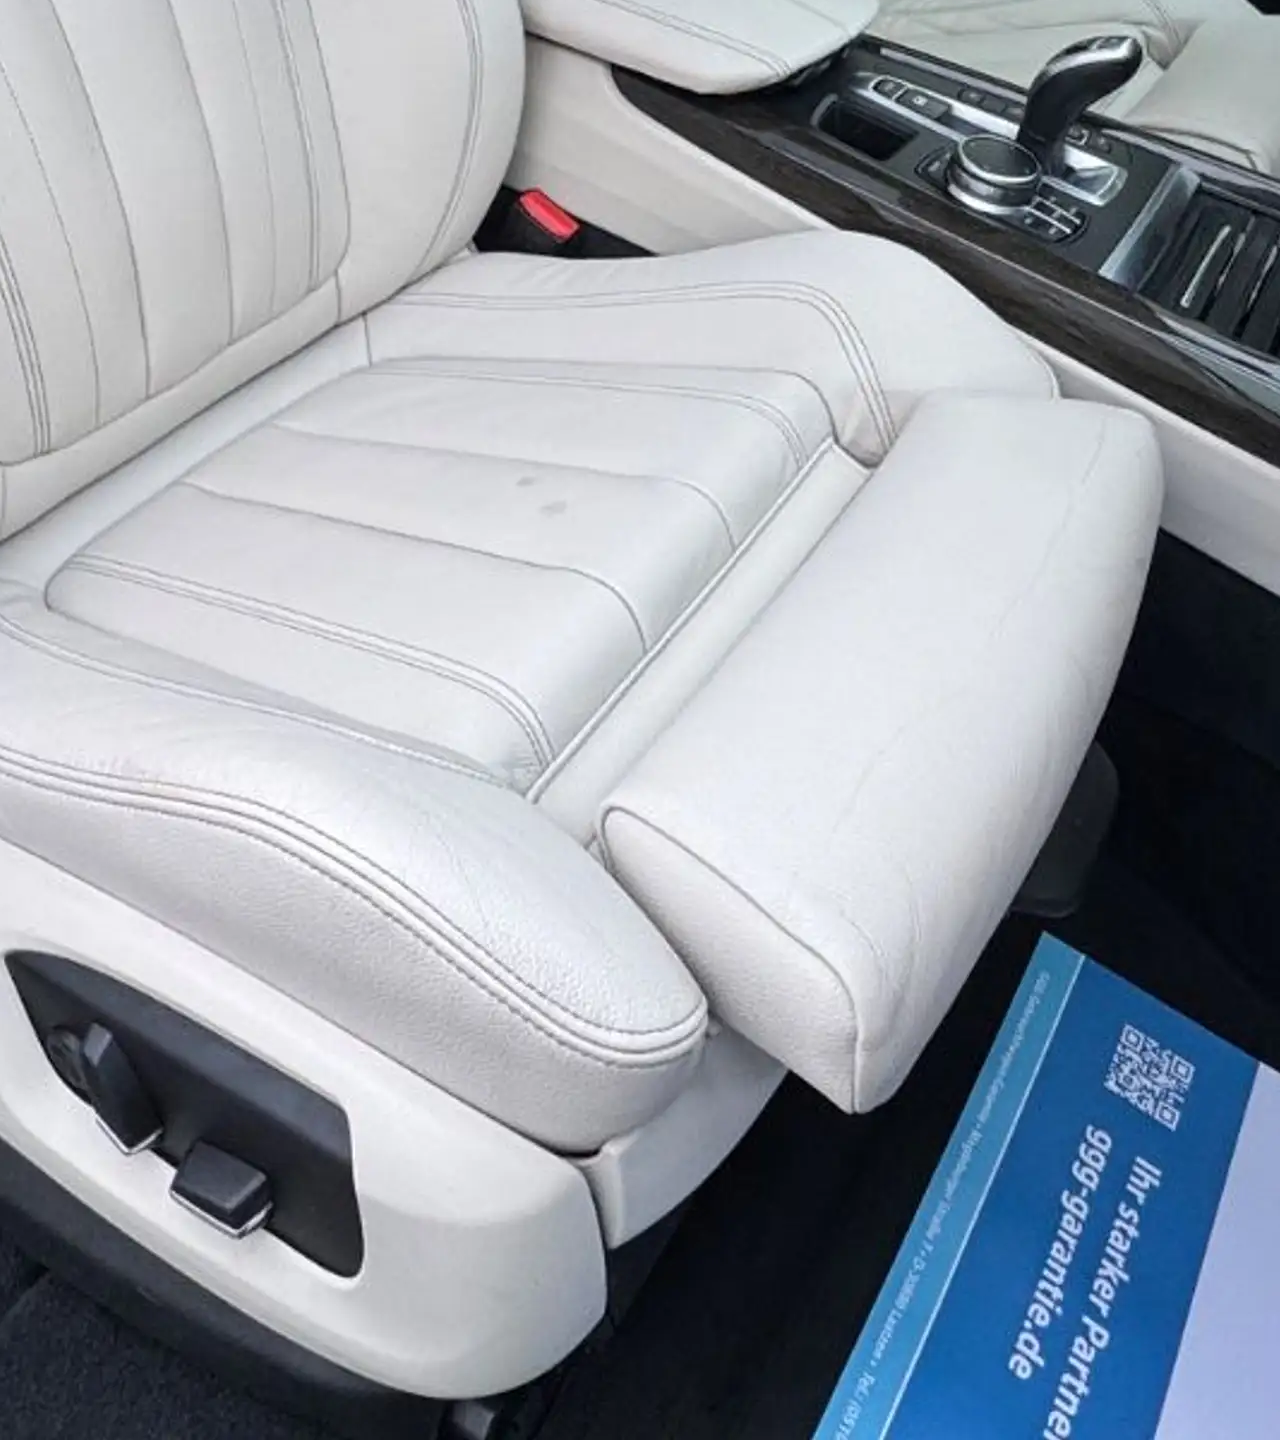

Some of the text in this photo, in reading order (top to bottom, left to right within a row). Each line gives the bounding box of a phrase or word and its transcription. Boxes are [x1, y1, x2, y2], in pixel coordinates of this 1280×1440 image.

[1125, 1155, 1162, 1207] Ihr
[1008, 1124, 1112, 1380] ggg-garantie.de
[1088, 1200, 1140, 1318] starker
